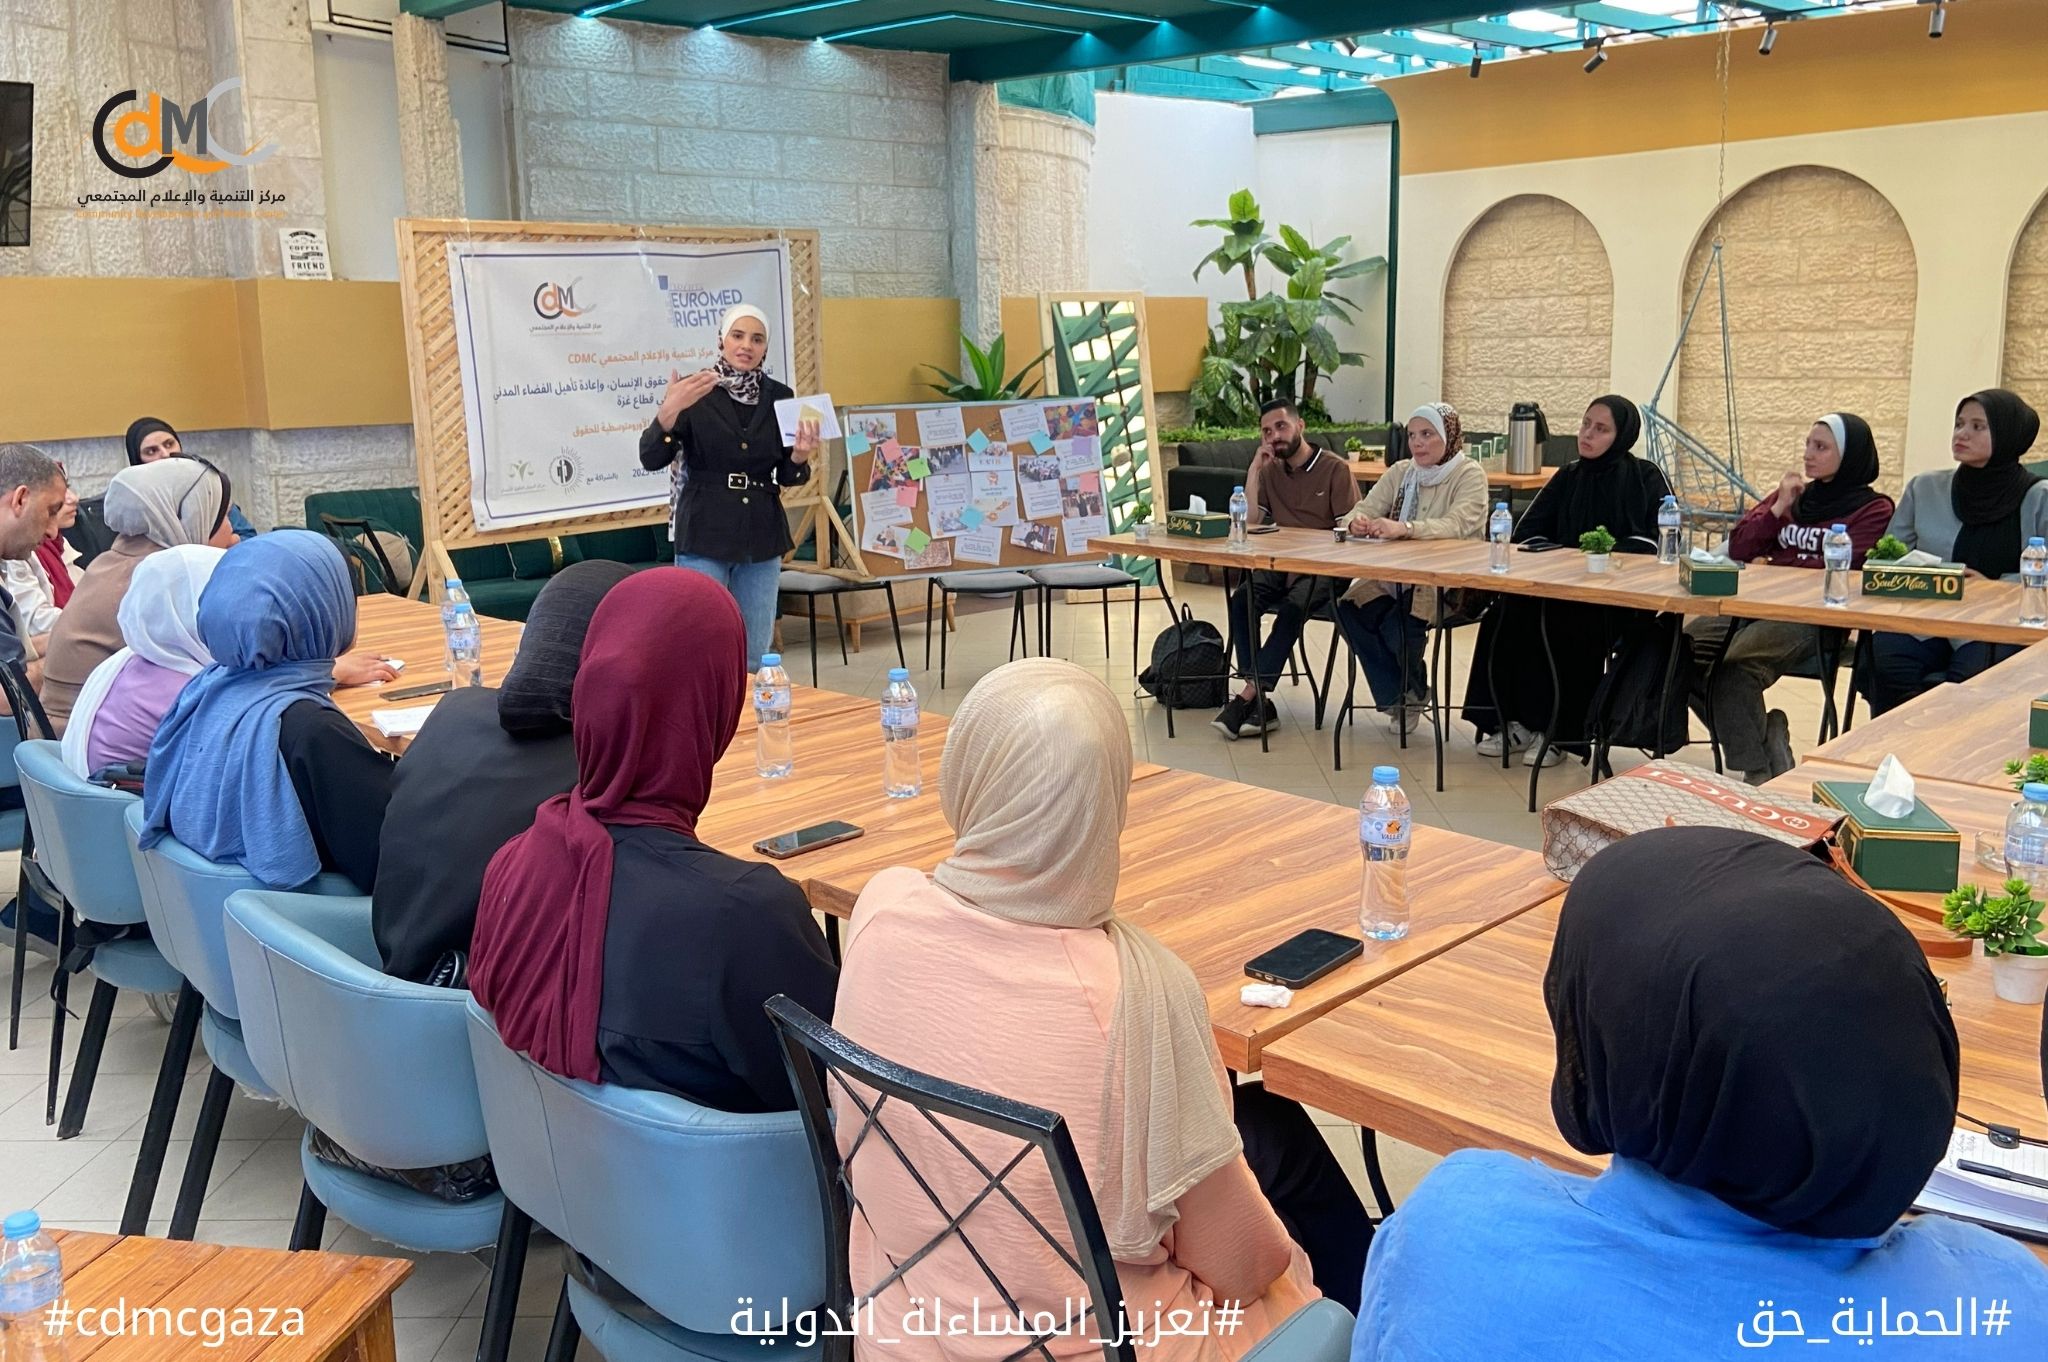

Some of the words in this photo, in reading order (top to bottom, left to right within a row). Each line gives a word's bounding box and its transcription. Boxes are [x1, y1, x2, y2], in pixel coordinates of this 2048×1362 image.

[292, 262, 325, 270] FRIEND
[671, 289, 743, 309] EUROMED
[568, 353, 597, 364] CDMC
[600, 353, 639, 367] المجتمعي
[641, 350, 670, 364] والإعلام
[671, 350, 698, 362] التنمية
[522, 382, 552, 395] الفضاء
[555, 377, 578, 395] تأهيل
[580, 379, 605, 393] وإعادة
[645, 377, 668, 390] حقوق
[493, 384, 520, 404] المدني
[617, 394, 631, 408] غزة
[633, 393, 654, 409] قطاع
[573, 423, 599, 438] للحقوق
[1195, 521, 1201, 535] 2
[1865, 572, 1896, 591] Soul
[1933, 575, 1958, 595] 10
[1649, 770, 1781, 820] GUCCI
